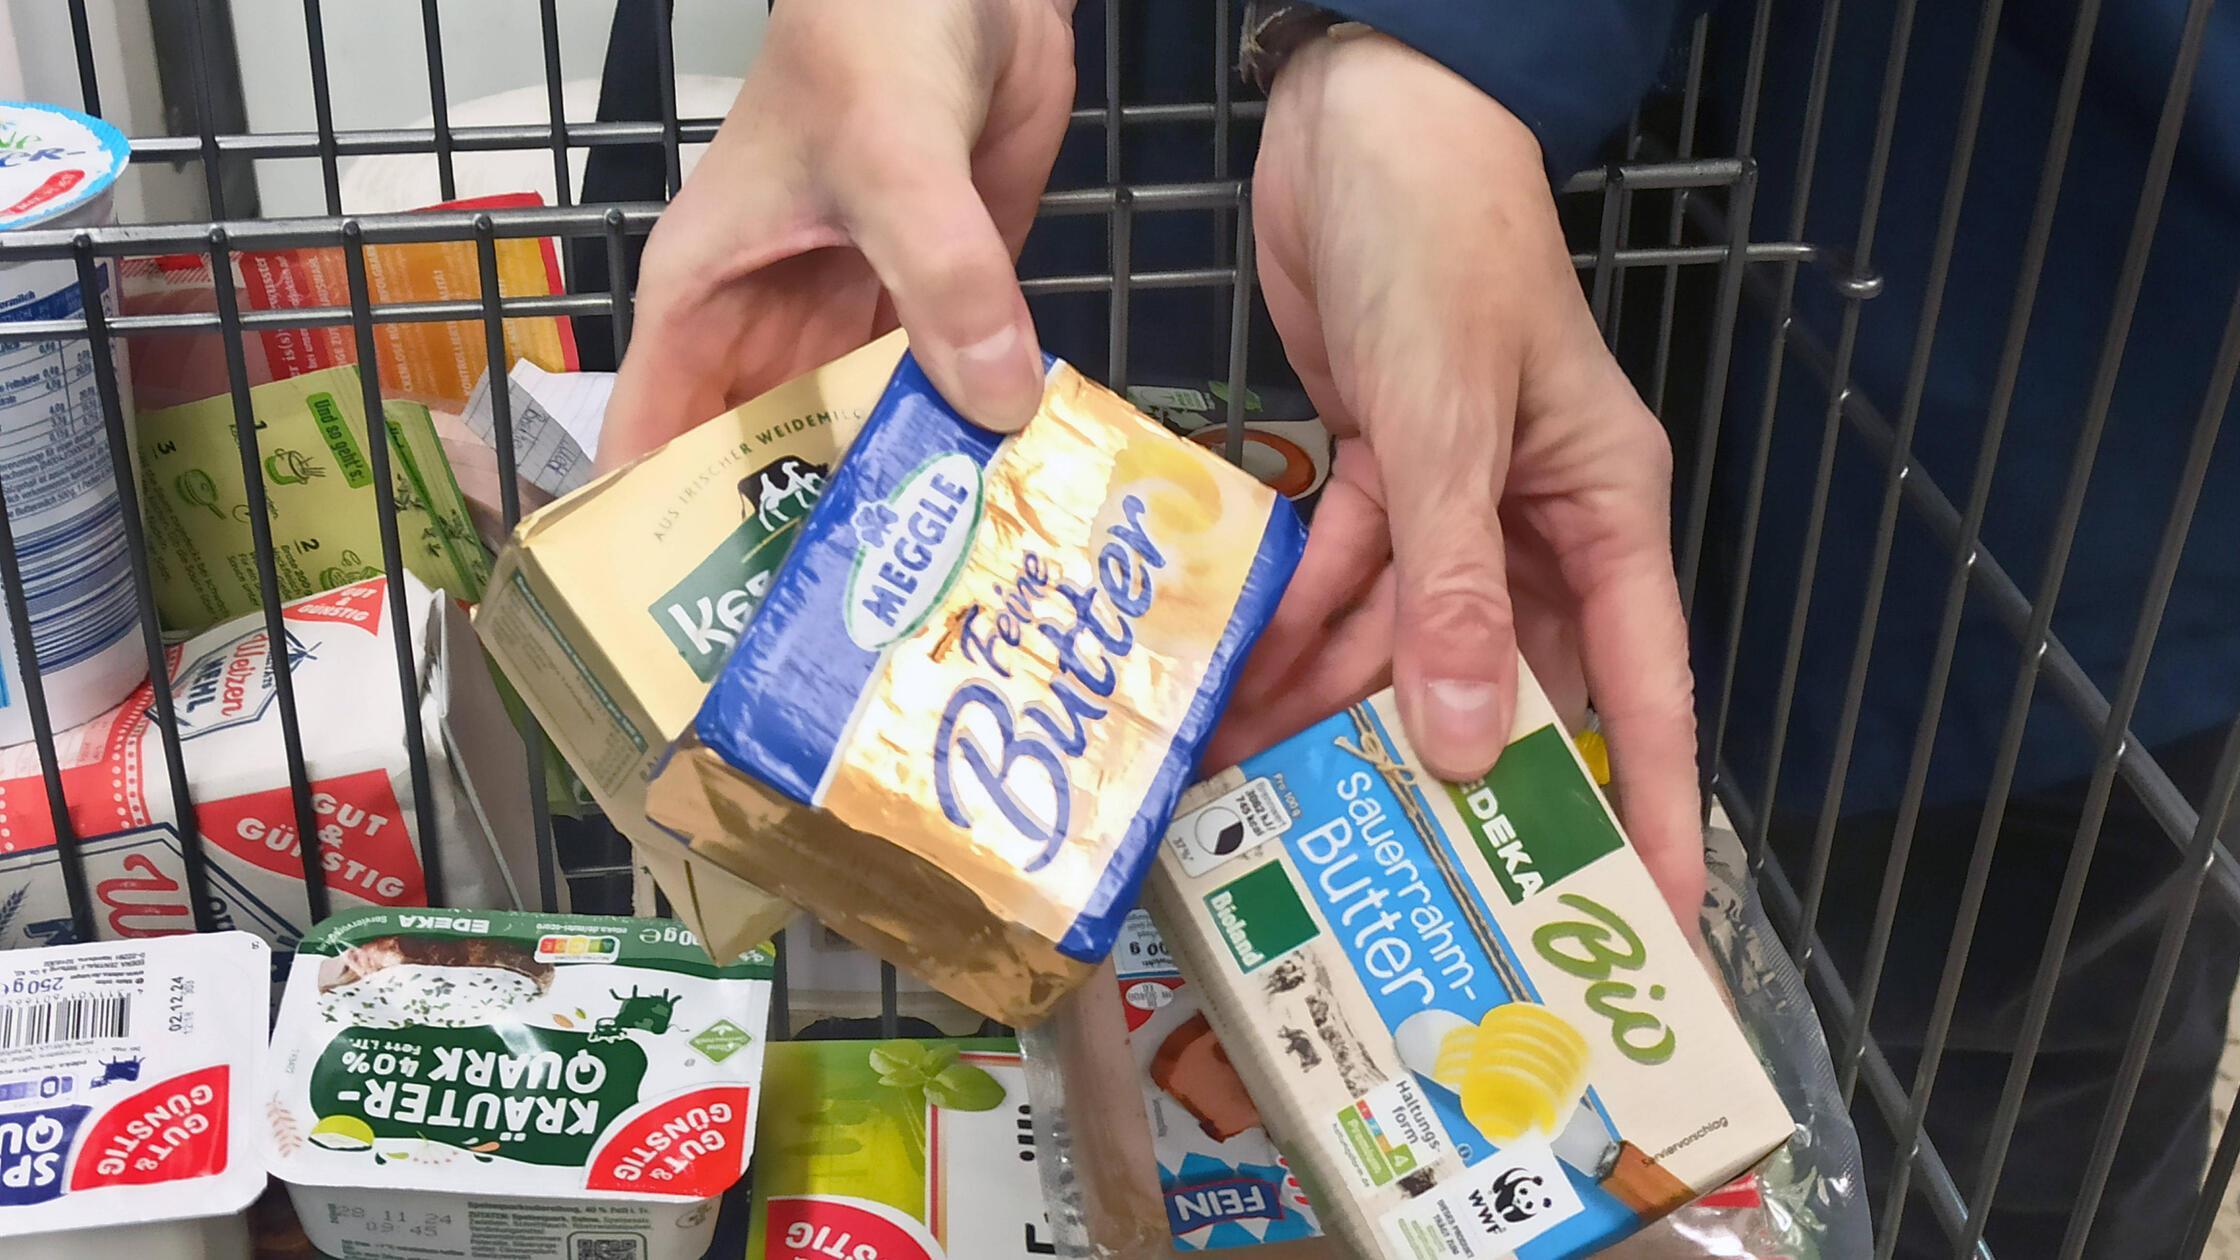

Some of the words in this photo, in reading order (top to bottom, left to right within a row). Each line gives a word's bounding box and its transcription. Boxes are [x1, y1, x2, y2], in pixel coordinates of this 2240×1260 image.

[314, 399, 338, 424] Und
[326, 424, 344, 441] so
[156, 440, 177, 455] 3
[682, 441, 753, 505] IRISCHER
[300, 538, 320, 553] 2
[652, 507, 681, 544] AUS
[862, 473, 968, 628] MEGGLE
[297, 603, 371, 622] GÜNSTIG
[340, 587, 378, 599] GUT
[958, 550, 1050, 679] Feine
[186, 655, 228, 714] MEHL
[220, 633, 269, 717] Weizen
[933, 494, 1167, 874] Butter
[1272, 772, 1286, 790] Pro
[311, 792, 389, 837] GUT
[318, 823, 344, 848] &
[1236, 795, 1252, 816] 745
[1246, 814, 1266, 838] kcal
[1336, 770, 1477, 1002] Sauerrahm-
[398, 914, 491, 934] EDEKA
[1209, 890, 1266, 969] Bioland
[1297, 816, 1436, 1006] Butter
[13, 980, 25, 993] g
[27, 976, 64, 995] 250
[1531, 892, 1677, 1067] Bio
[168, 976, 185, 1032] 02.12.24
[341, 1051, 421, 1078] 40%
[383, 1042, 422, 1055] Fett
[427, 1046, 607, 1094] QUARK
[97, 1083, 214, 1176] GÜNSTIG
[337, 1078, 600, 1142] KRÄUTER-
[1391, 1104, 1419, 1145] form
[1394, 1079, 1442, 1155] Haltungs-
[148, 1112, 209, 1161] GUT
[613, 1102, 733, 1181] GÜNSTIG
[665, 1130, 726, 1175] GUT
[1346, 1118, 1383, 1176] Premium
[1641, 1114, 1730, 1169] Serviervorschlag
[133, 1156, 159, 1172] &
[649, 1167, 674, 1181] &
[1393, 1153, 1410, 1169] 4
[1174, 1184, 1267, 1222] FEIN
[1467, 1188, 1502, 1235] WWF
